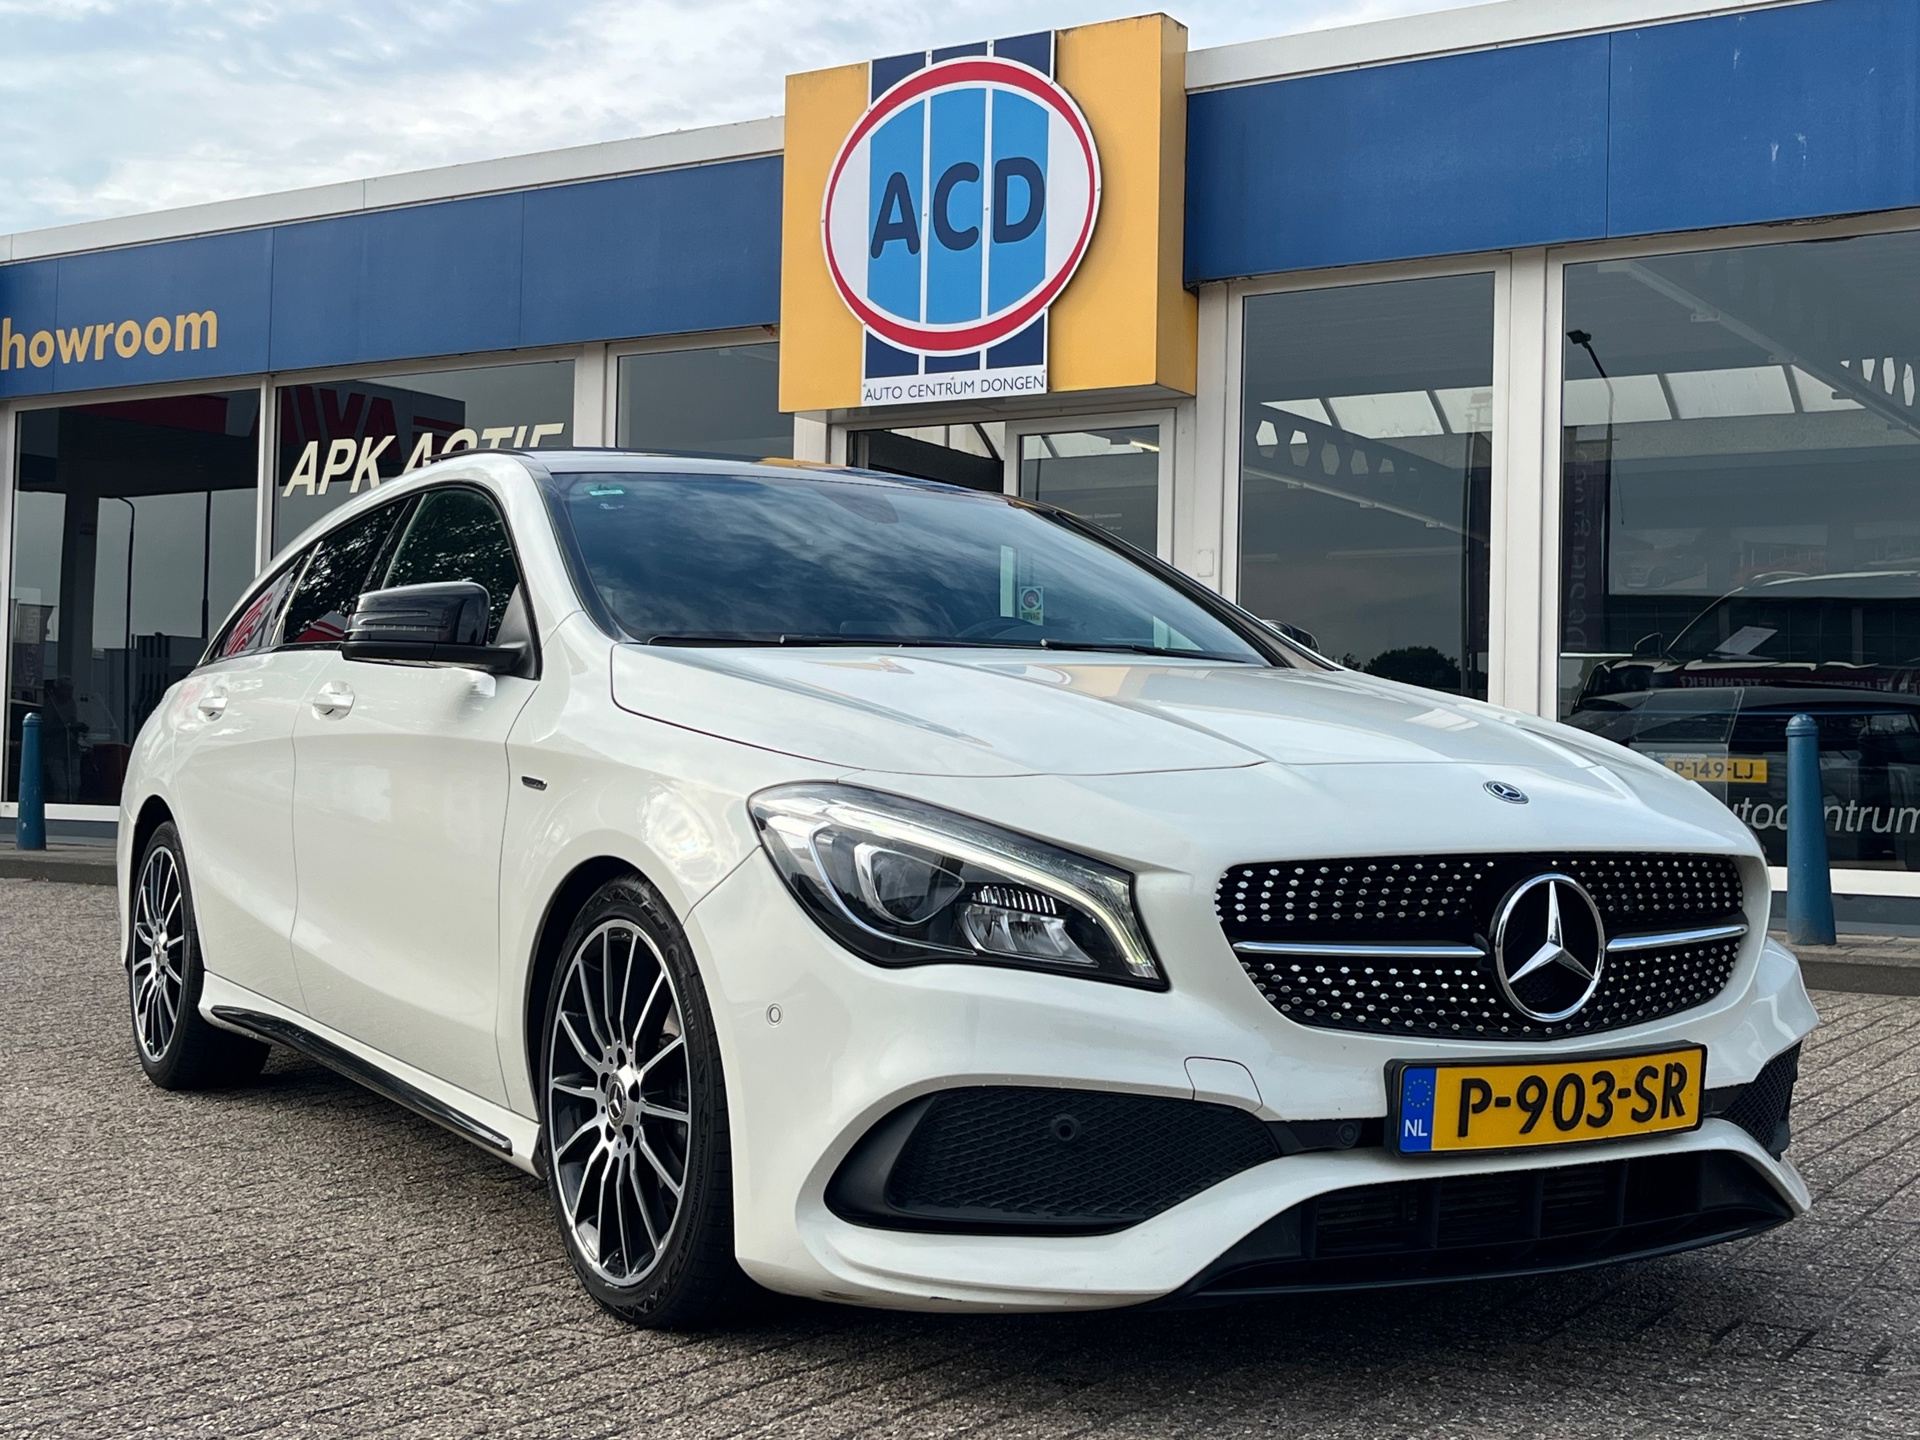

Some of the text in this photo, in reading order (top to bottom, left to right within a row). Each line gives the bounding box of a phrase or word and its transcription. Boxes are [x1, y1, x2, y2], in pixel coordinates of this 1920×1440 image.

[869, 157, 1045, 259] ACD
[864, 375, 1045, 401] AUTO CENTRUM DONGEN
[283, 435, 396, 498] APK
[1674, 762, 1754, 780] P-149-LJ
[1457, 1062, 1688, 1137] P-903-SR
[1404, 1119, 1428, 1137] NL
